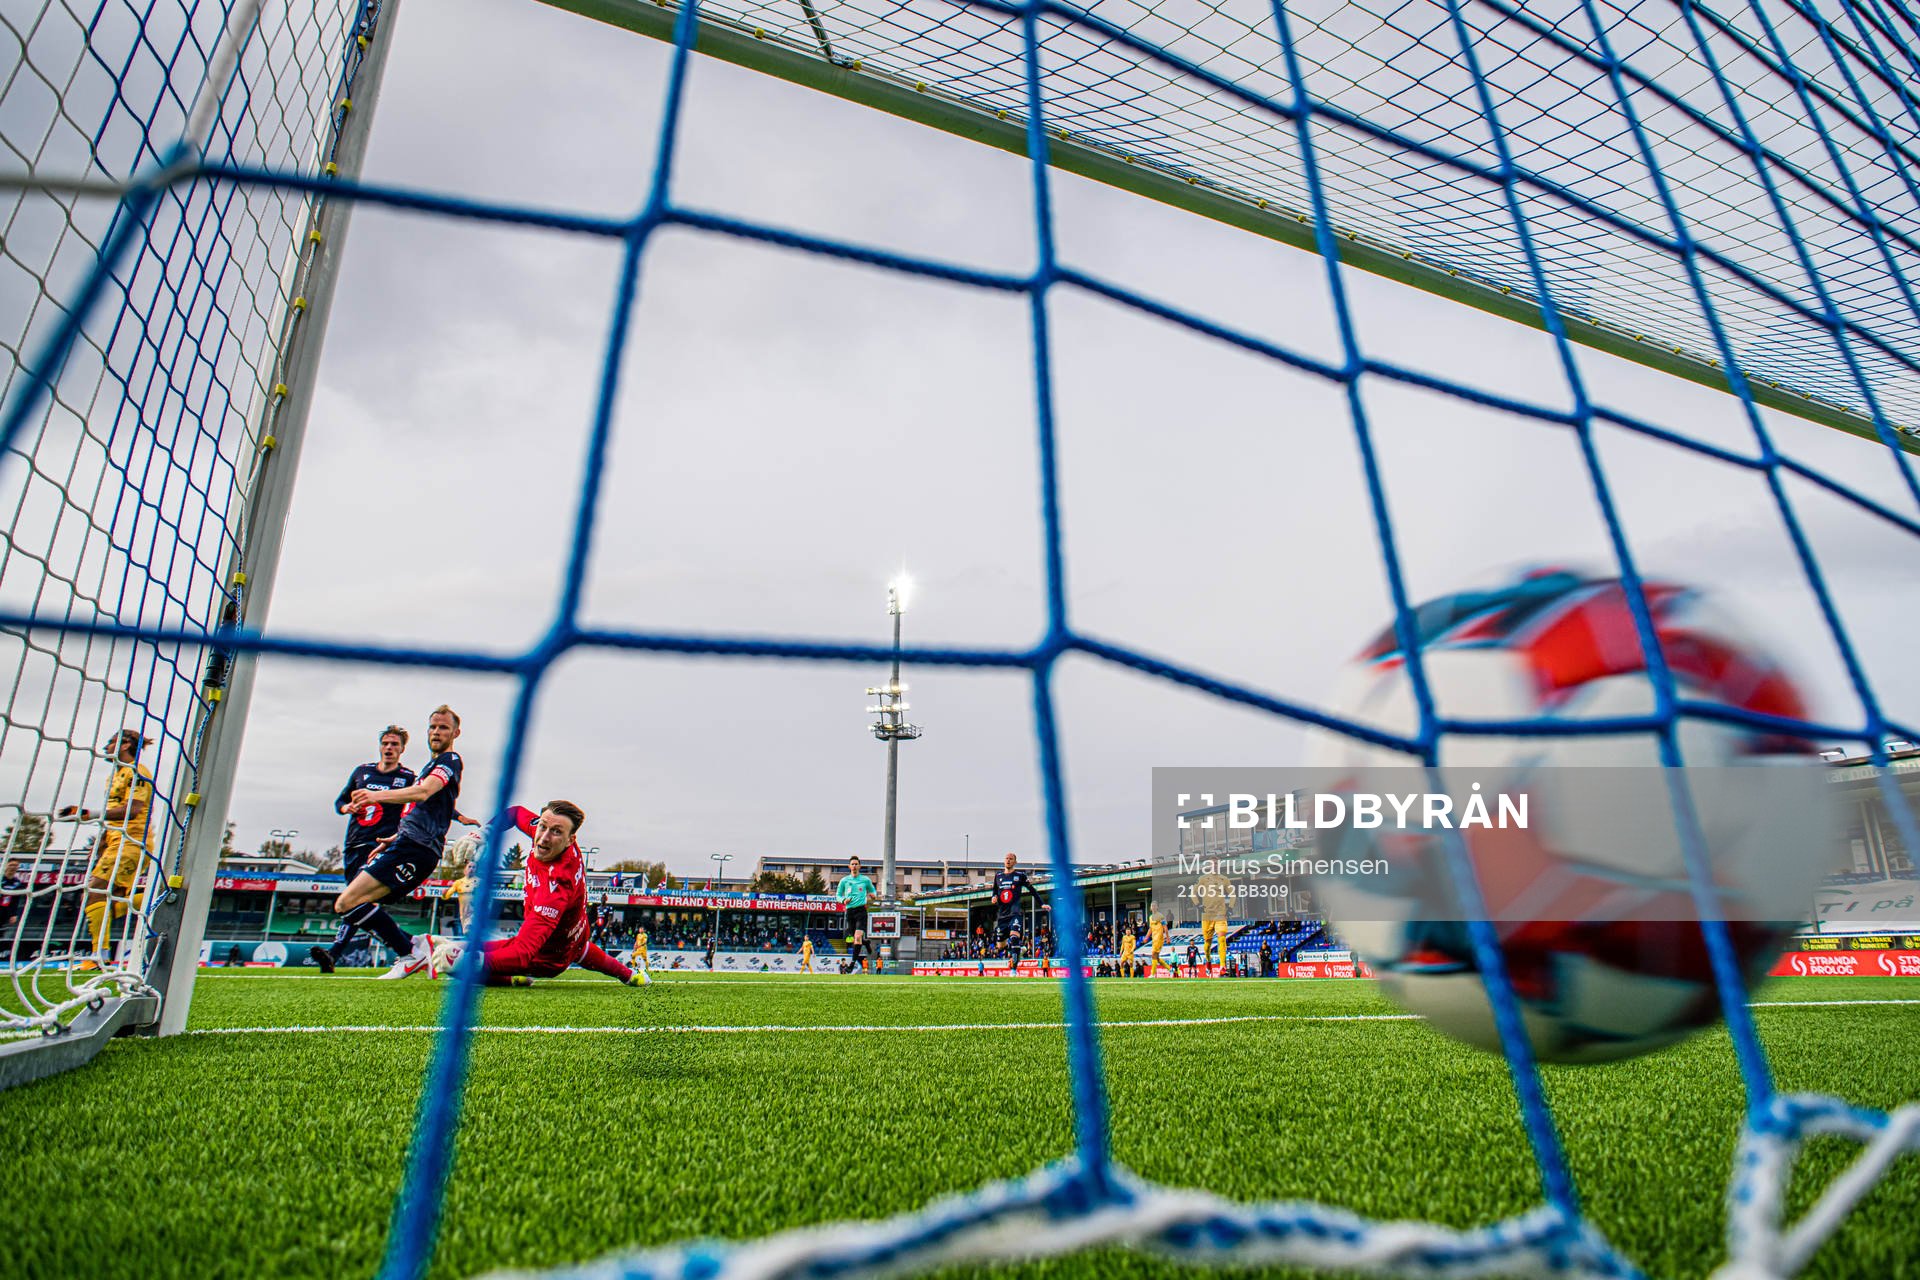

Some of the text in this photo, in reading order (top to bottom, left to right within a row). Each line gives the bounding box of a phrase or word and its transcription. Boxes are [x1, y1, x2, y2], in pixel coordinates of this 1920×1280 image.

[215, 879, 233, 889] AS
[662, 896, 704, 907] STRAND
[707, 898, 715, 907] &
[717, 899, 750, 909] STUBØ
[756, 899, 823, 910] ENTREPRENØR
[825, 902, 837, 911] AS
[1809, 956, 1858, 965] STRANDA
[1898, 955, 1920, 965] STR
[1811, 966, 1854, 974] PROLOG
